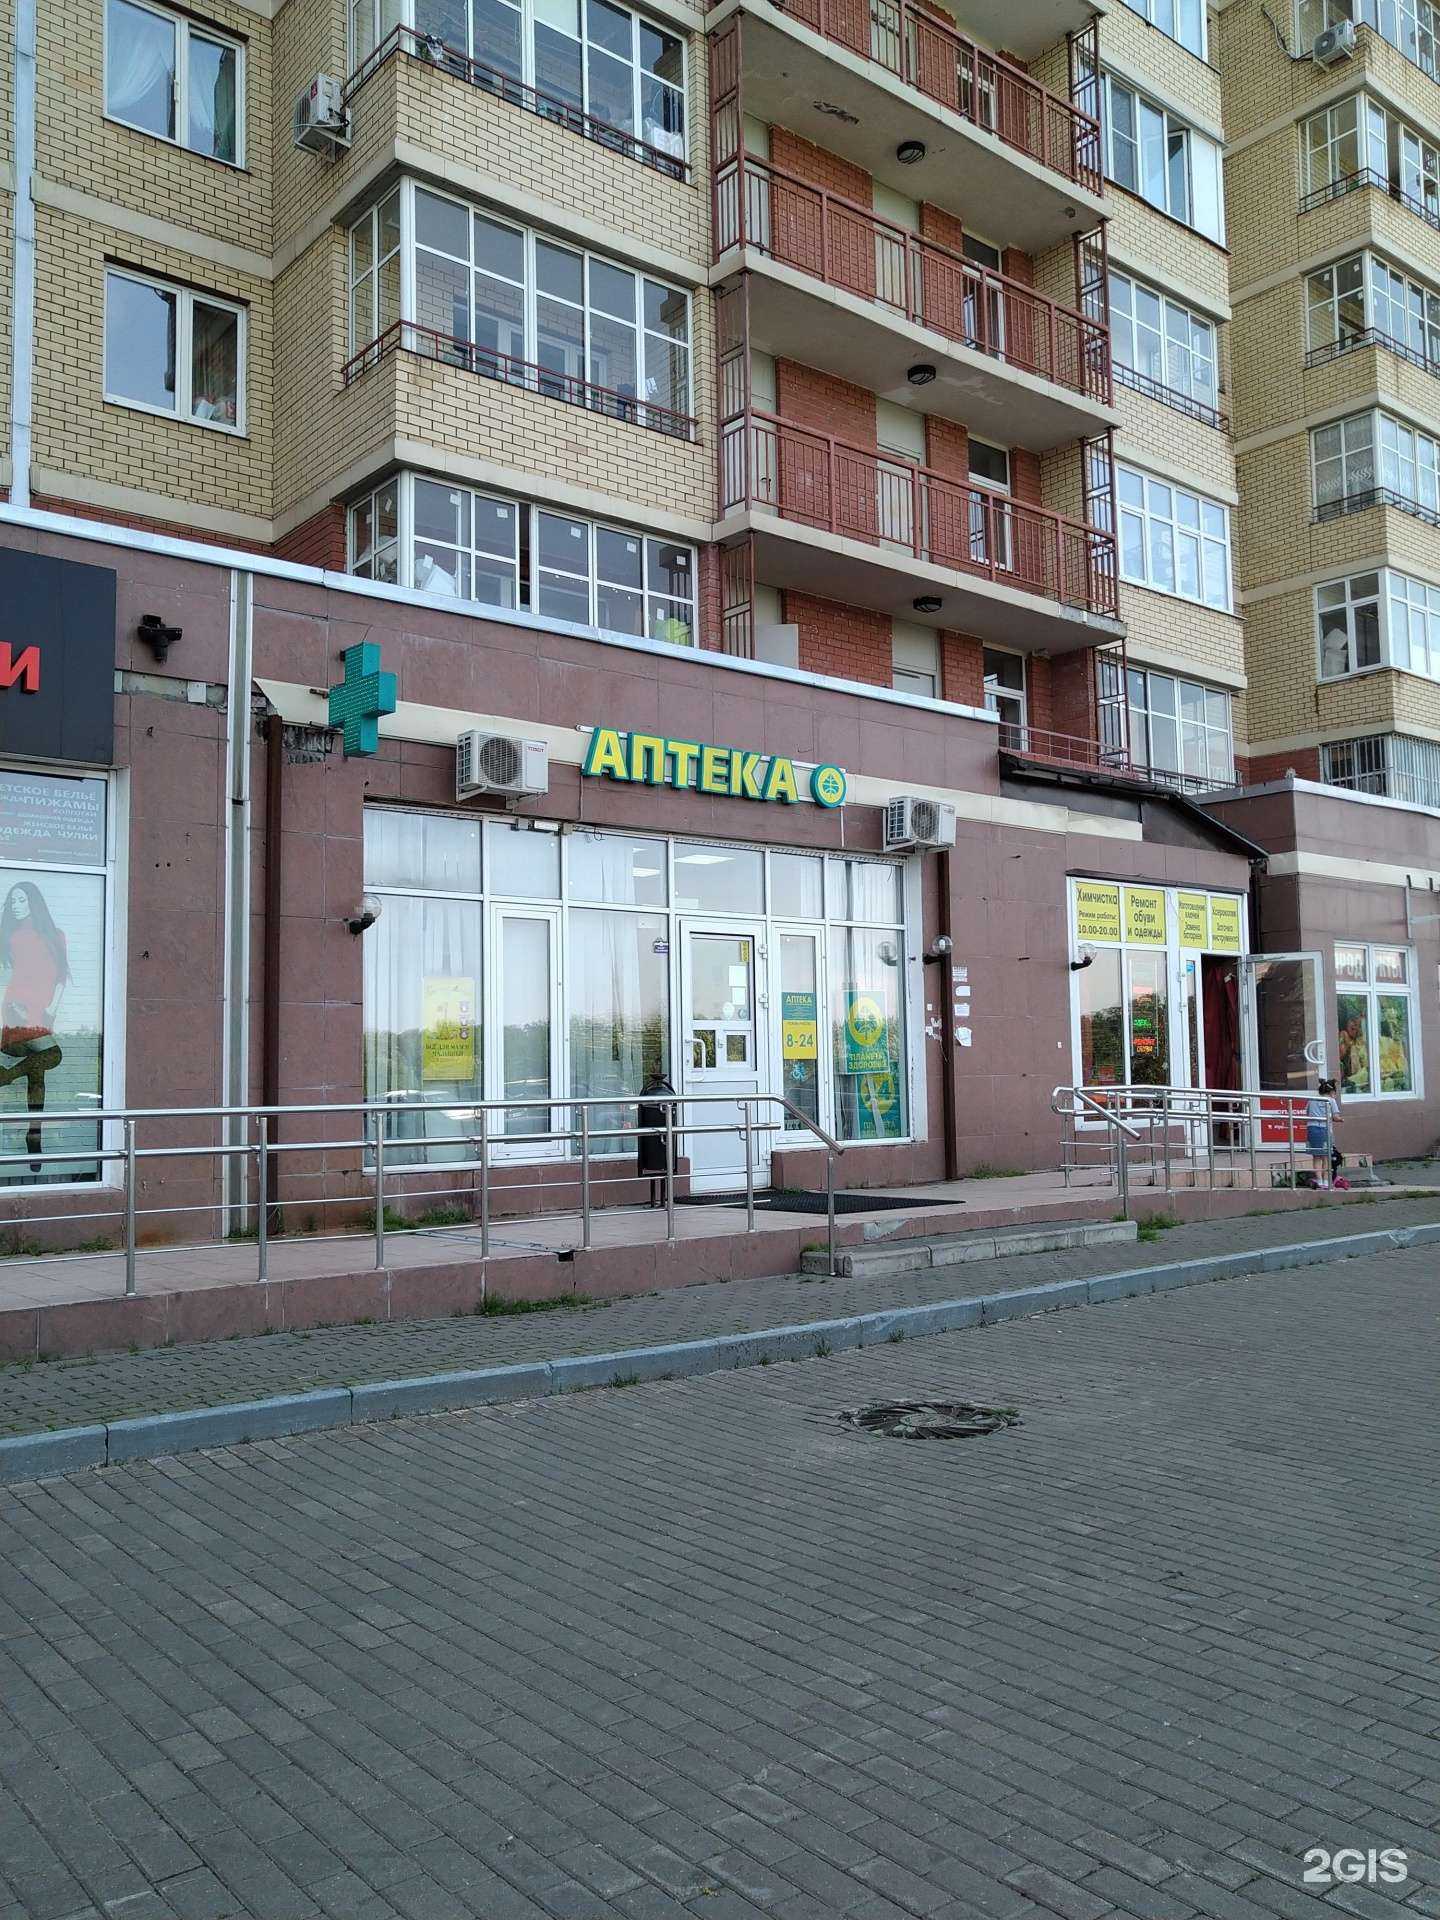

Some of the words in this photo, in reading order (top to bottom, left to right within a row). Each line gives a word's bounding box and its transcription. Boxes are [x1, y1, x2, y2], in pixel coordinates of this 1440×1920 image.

[581, 727, 799, 804] АПТЕКА
[24, 796, 99, 812] ПИЖАМЫ
[1077, 887, 1118, 905] Химчистка
[1130, 894, 1157, 909] Ремонт
[1078, 910, 1096, 919] Режим
[1133, 910, 1156, 926] обуви
[1078, 924, 1118, 937] 10.00-20.00
[1127, 927, 1133, 937] и
[1133, 927, 1164, 940] одежды
[785, 994, 813, 1004] АПТЕКА
